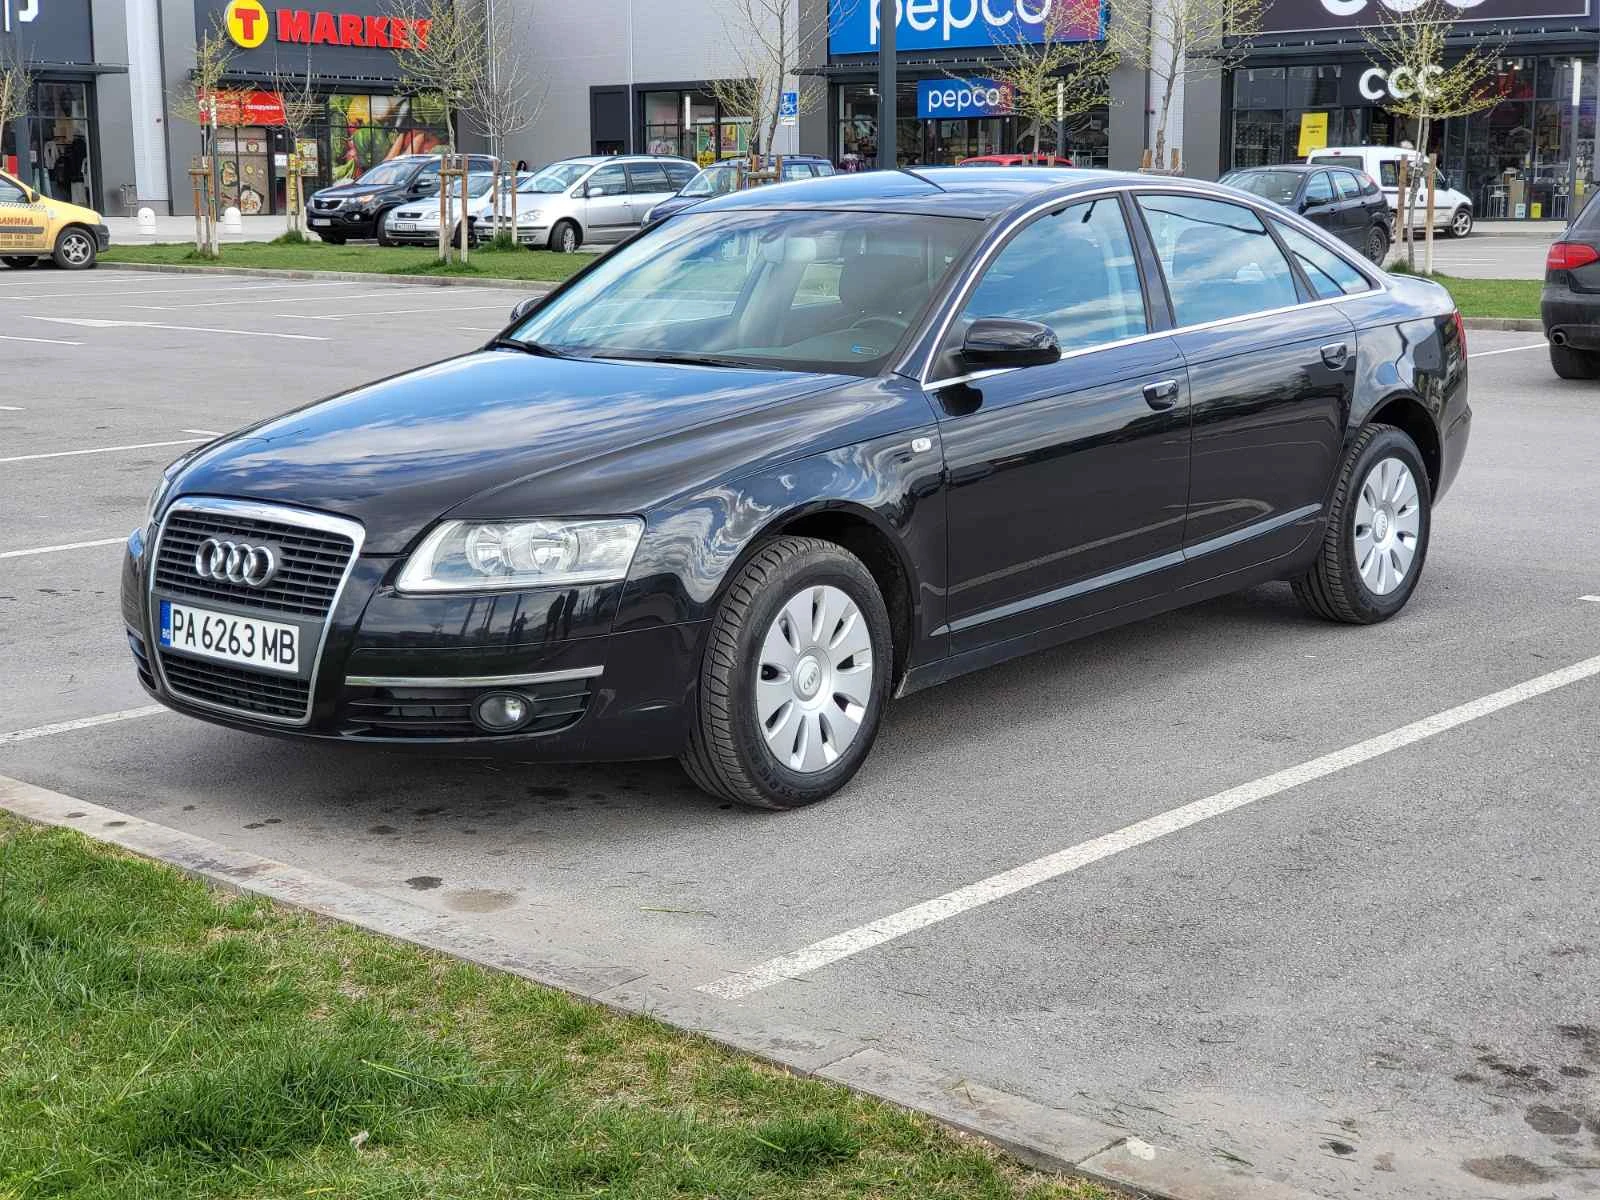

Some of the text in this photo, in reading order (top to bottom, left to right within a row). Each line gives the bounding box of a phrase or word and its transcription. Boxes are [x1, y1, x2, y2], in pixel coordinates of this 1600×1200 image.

[235, 7, 433, 50] T MARKET
[928, 87, 1000, 113] pepco
[162, 608, 296, 665] BG PA 6263 MB
